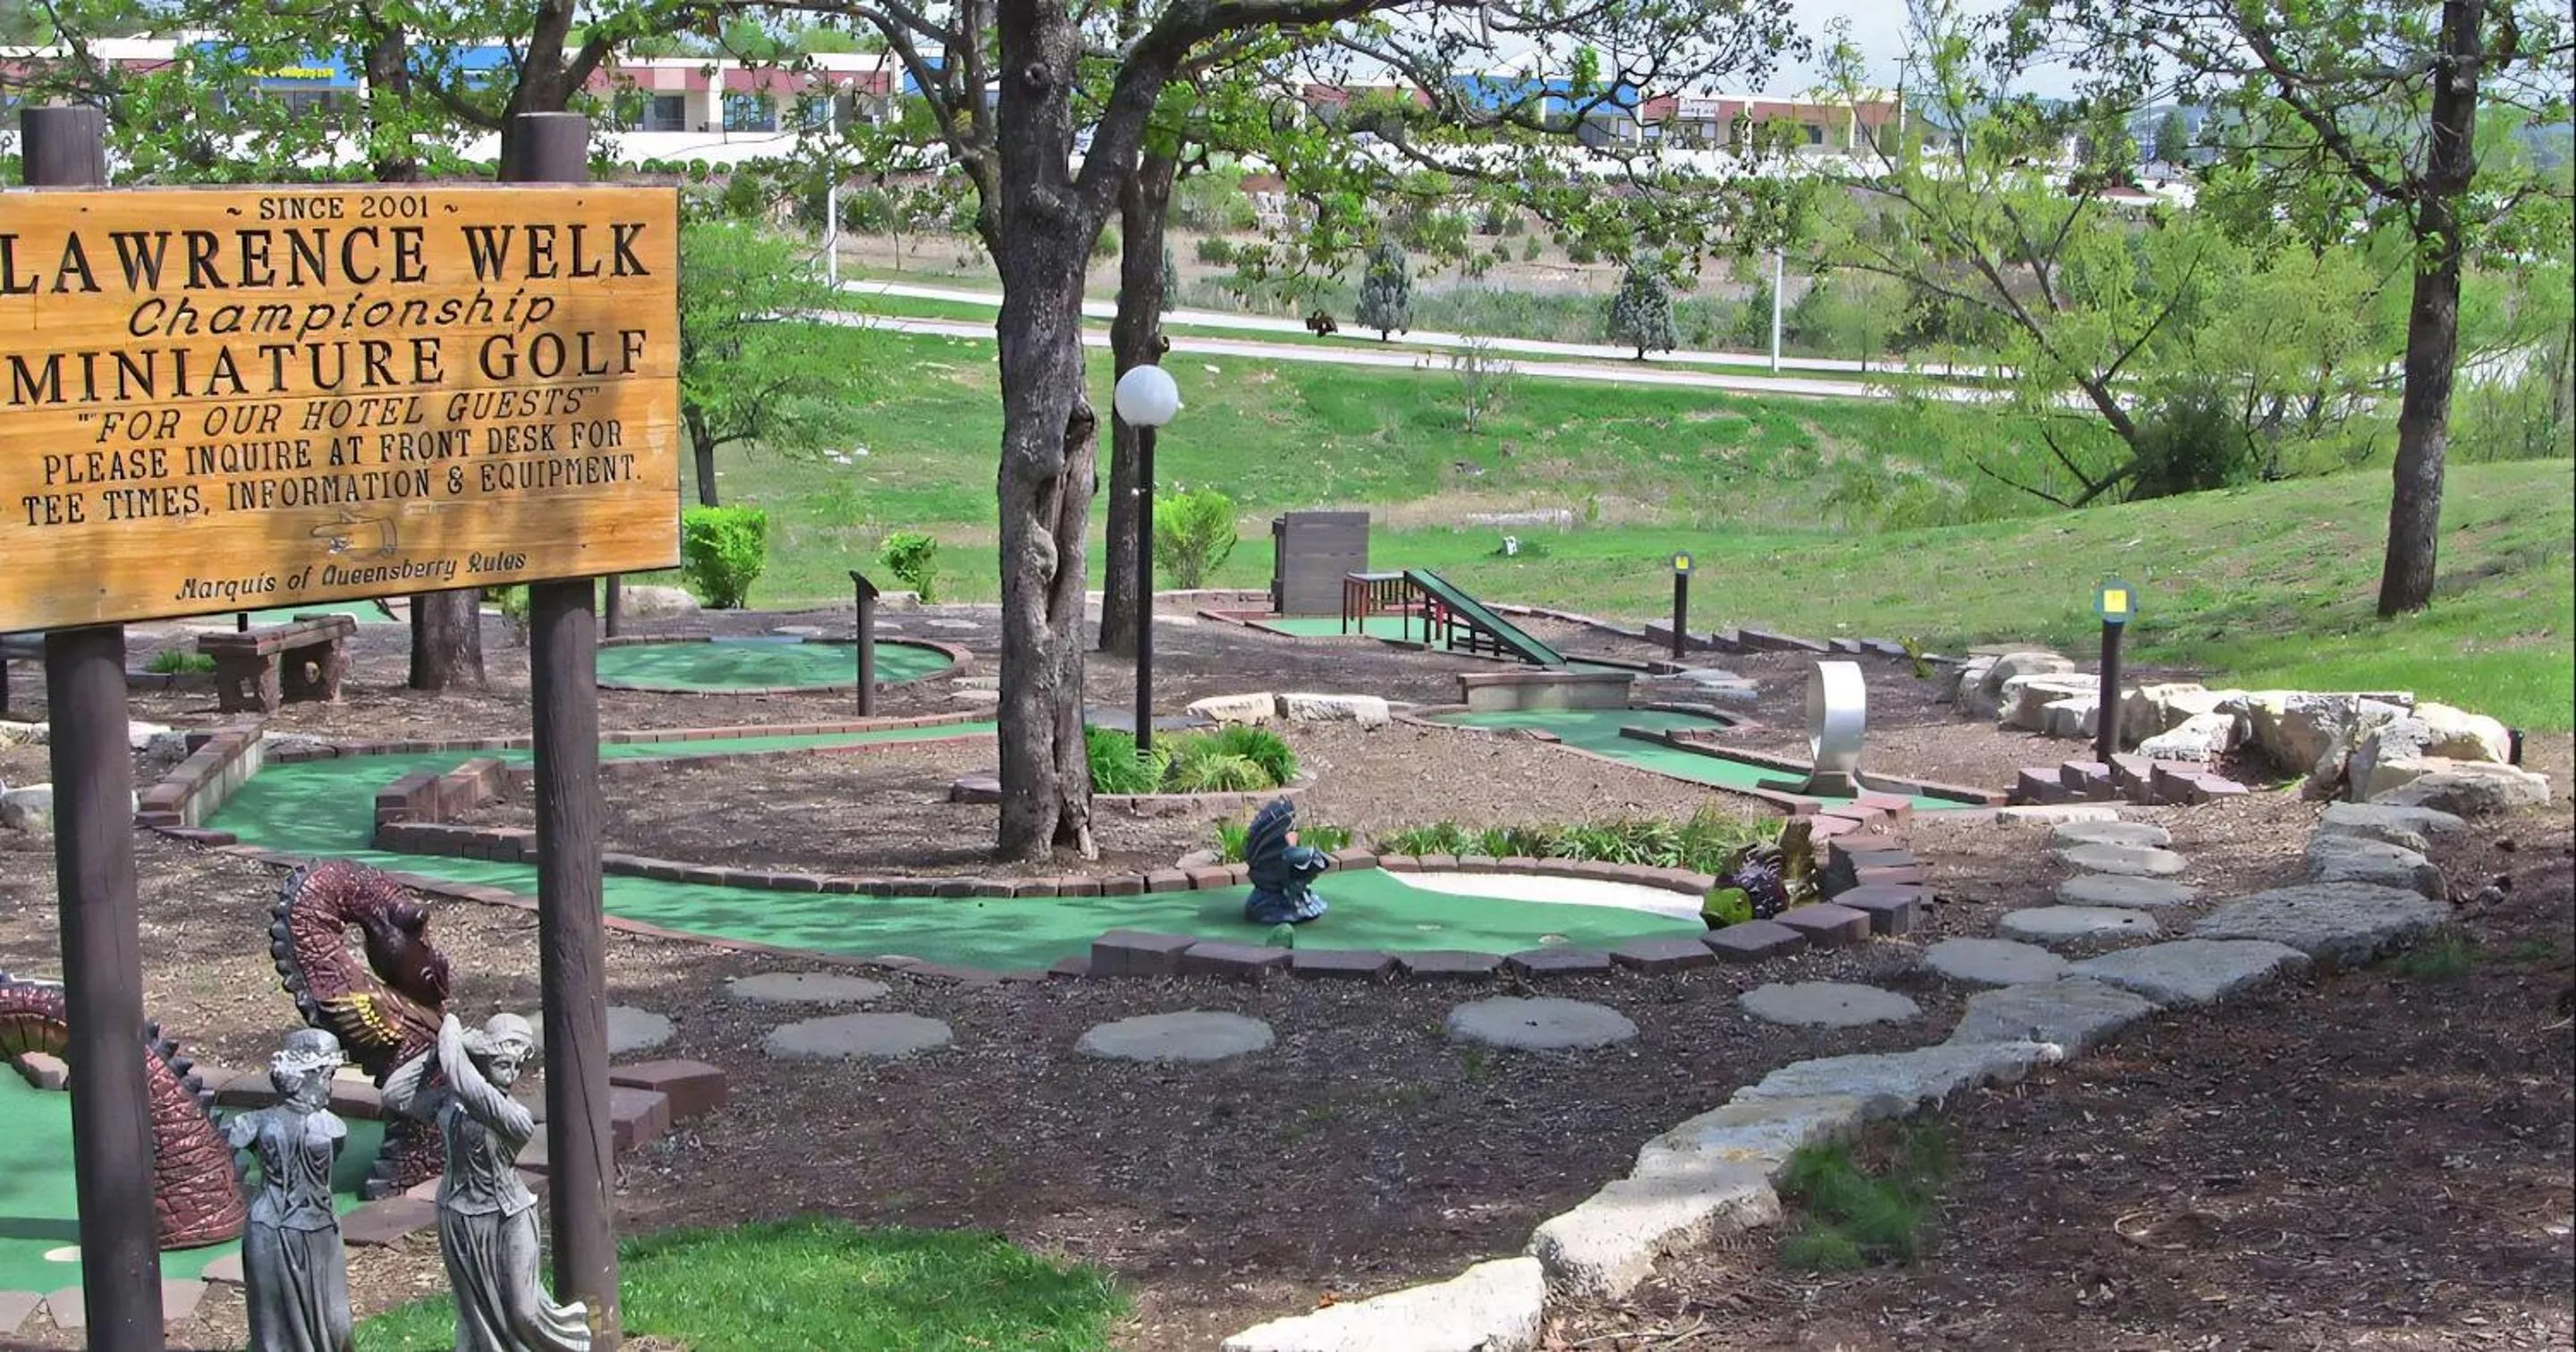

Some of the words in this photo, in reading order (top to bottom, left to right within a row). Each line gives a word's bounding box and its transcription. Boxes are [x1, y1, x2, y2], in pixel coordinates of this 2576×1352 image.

[259, 196, 344, 220] SINCE
[360, 195, 429, 219] 2001
[0, 225, 428, 294] LAWRENCE
[461, 224, 650, 282] WELK
[128, 287, 556, 344] Championship
[6, 336, 445, 405] MINIATURE
[479, 330, 648, 381] GOLF
[203, 403, 282, 437] OUR
[301, 396, 424, 432] HOTEL
[43, 448, 169, 486] PLEASE
[185, 438, 312, 477] INQUIRE
[328, 435, 364, 466] AT
[379, 429, 472, 463] FRONT
[487, 423, 558, 455] DESK
[572, 419, 623, 449] FOR
[22, 492, 86, 527] TEE
[102, 485, 212, 521] TIMES,
[225, 469, 431, 511] INFORMATION
[447, 465, 463, 495] &
[481, 454, 642, 493] EQUIPMENT.
[175, 573, 278, 602] Marquis
[288, 565, 314, 589] of
[322, 558, 458, 587] Queensberry
[467, 551, 528, 574] Rules
